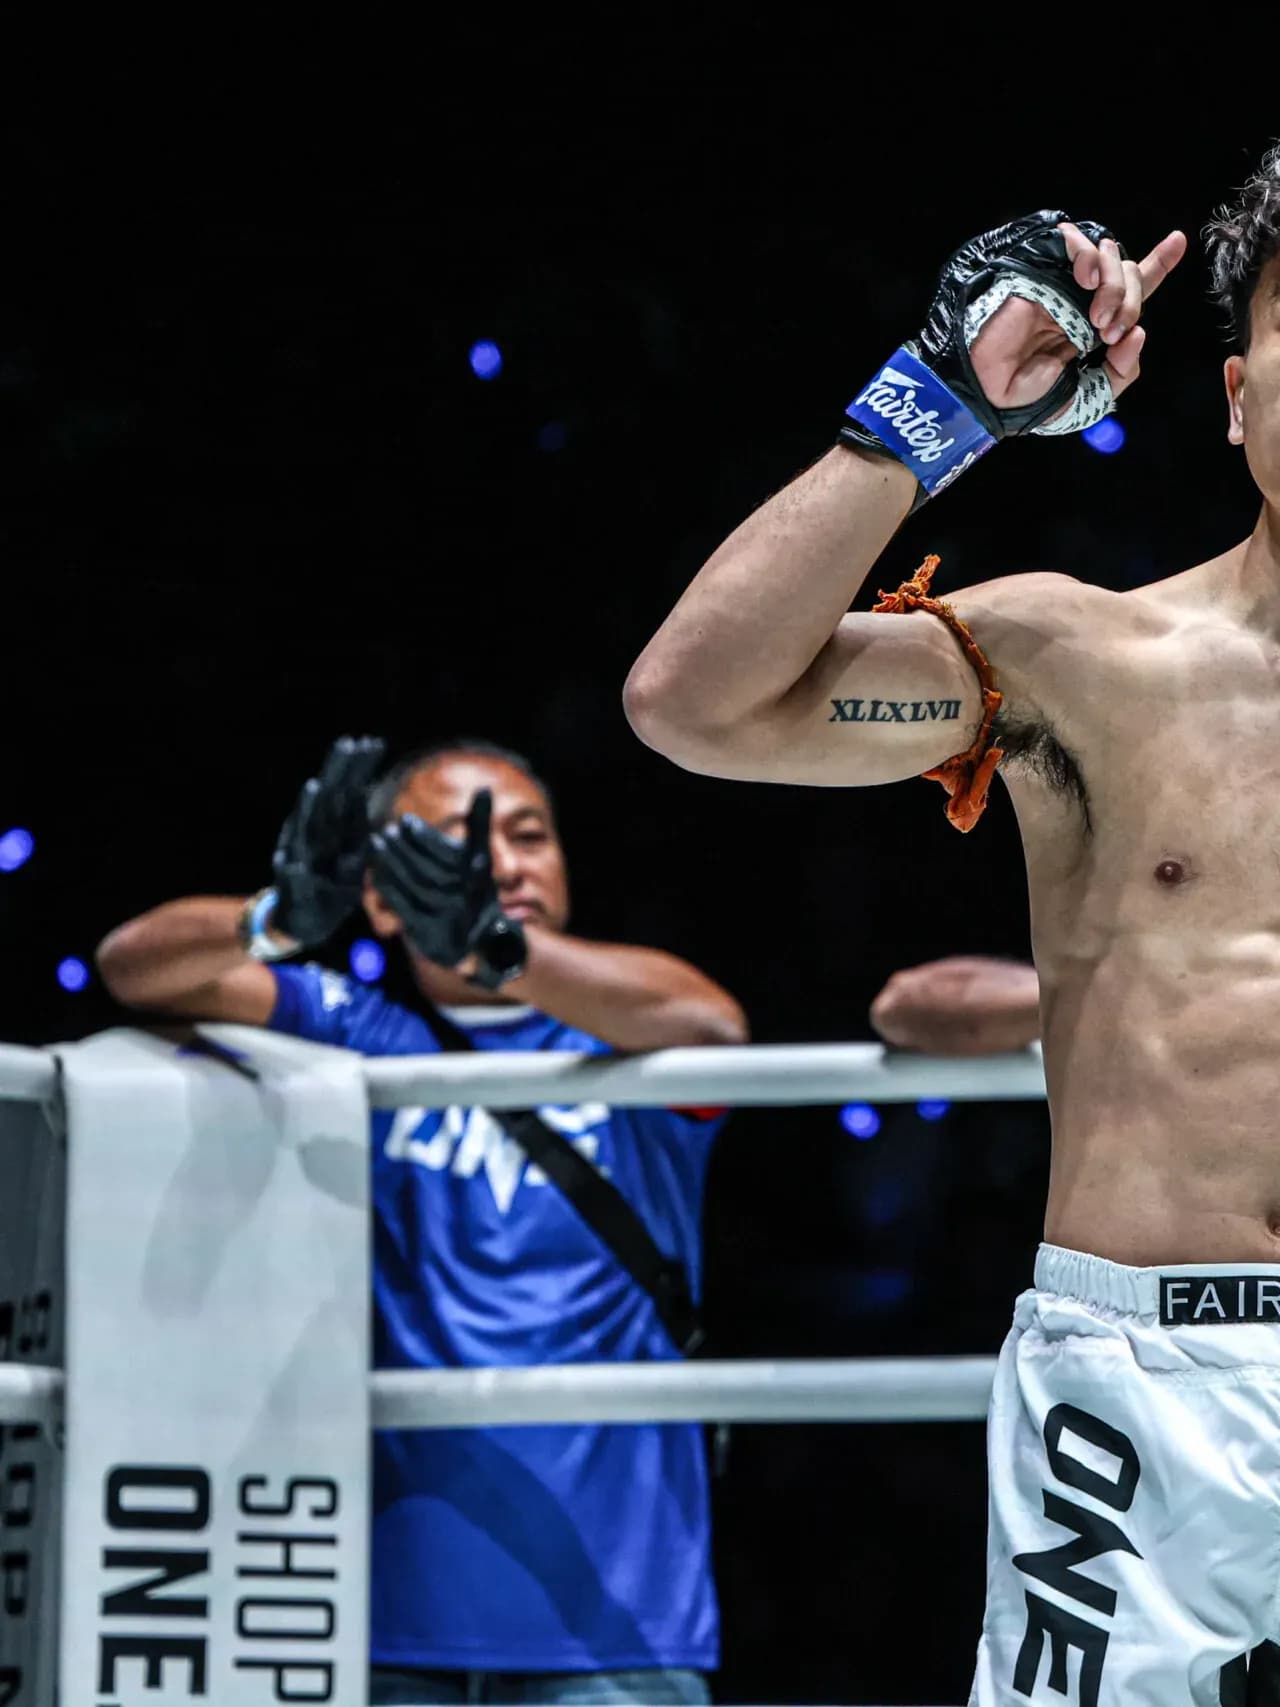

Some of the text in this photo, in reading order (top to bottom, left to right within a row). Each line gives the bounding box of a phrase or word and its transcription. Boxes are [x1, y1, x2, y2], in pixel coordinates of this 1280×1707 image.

[856, 367, 954, 463] Fairtex
[232, 1474, 340, 1704] SHOP
[1012, 1403, 1144, 1707] ONE
